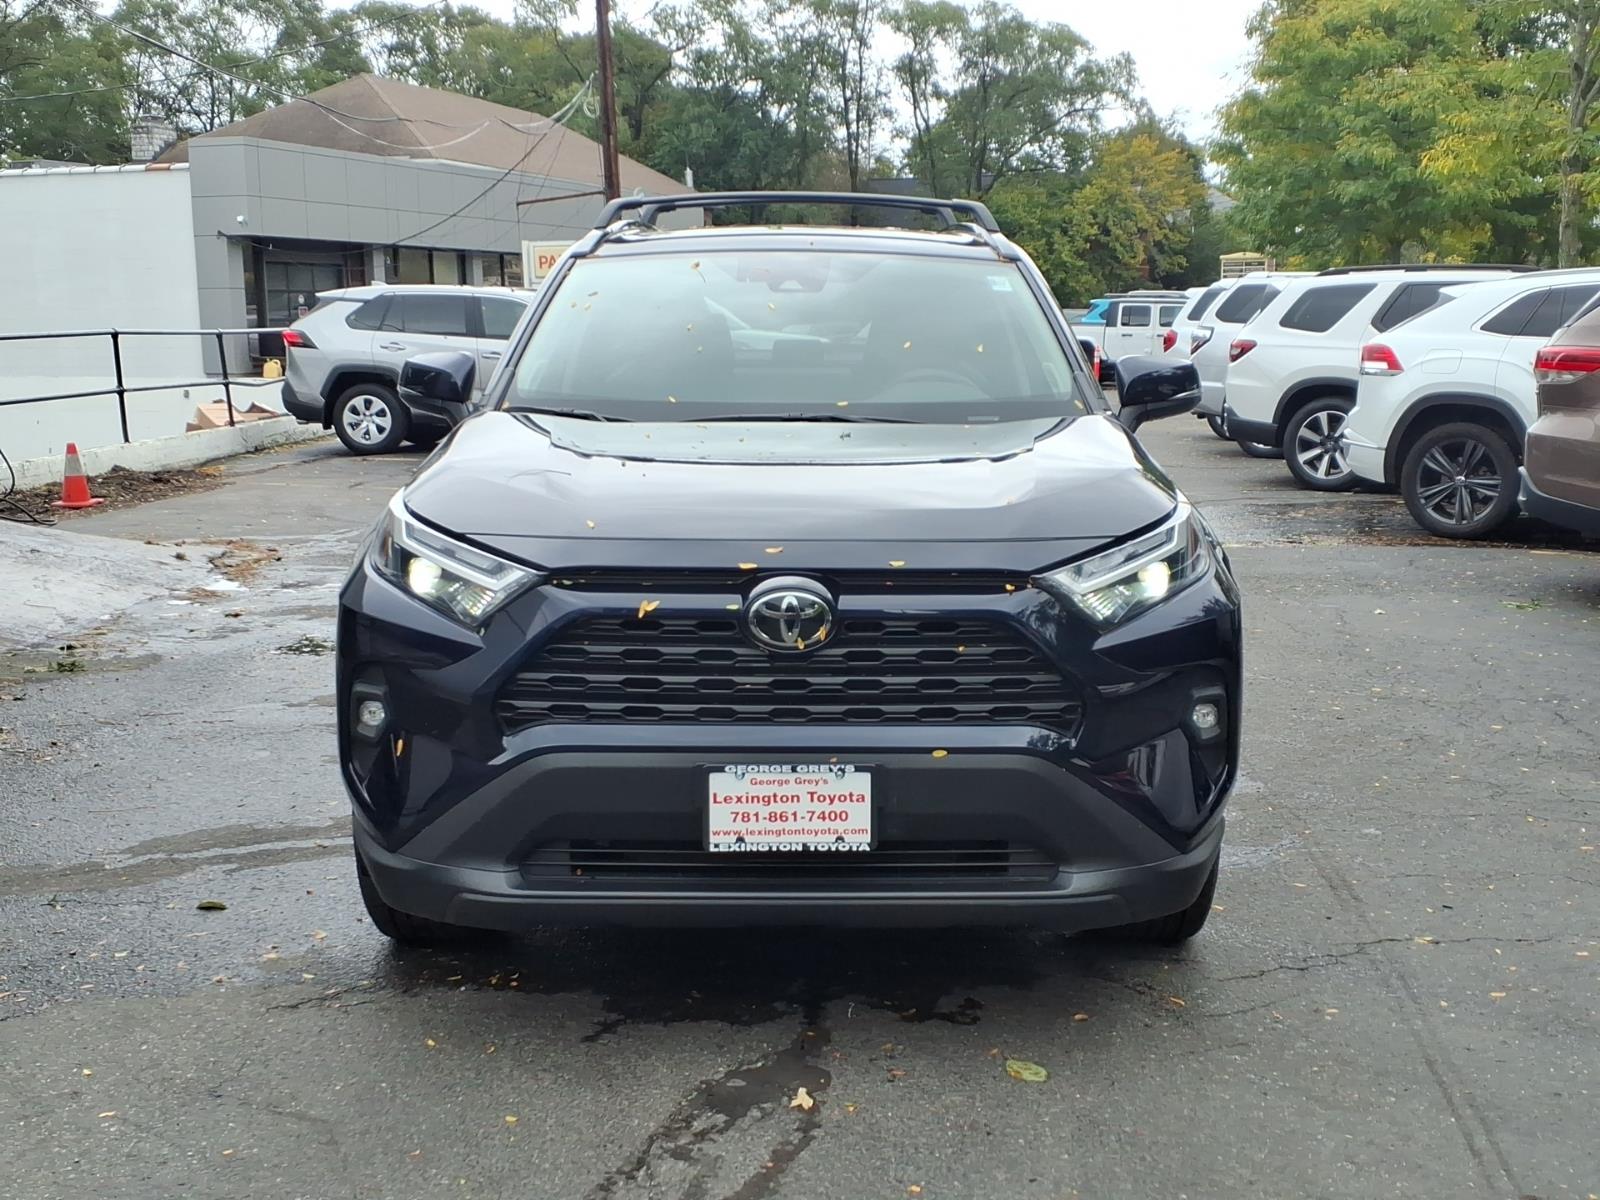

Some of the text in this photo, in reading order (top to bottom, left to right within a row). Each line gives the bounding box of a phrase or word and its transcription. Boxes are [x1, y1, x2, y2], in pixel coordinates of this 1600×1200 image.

[724, 764, 856, 773] GEORGE GREY'S
[750, 776, 829, 787] George Grey's
[712, 791, 866, 806] Lexington Toyota
[730, 810, 849, 823] 781-861-7400
[711, 827, 869, 837] www.lexingtontoyota.com
[709, 842, 871, 852] LEXINGTON TOYOTA
